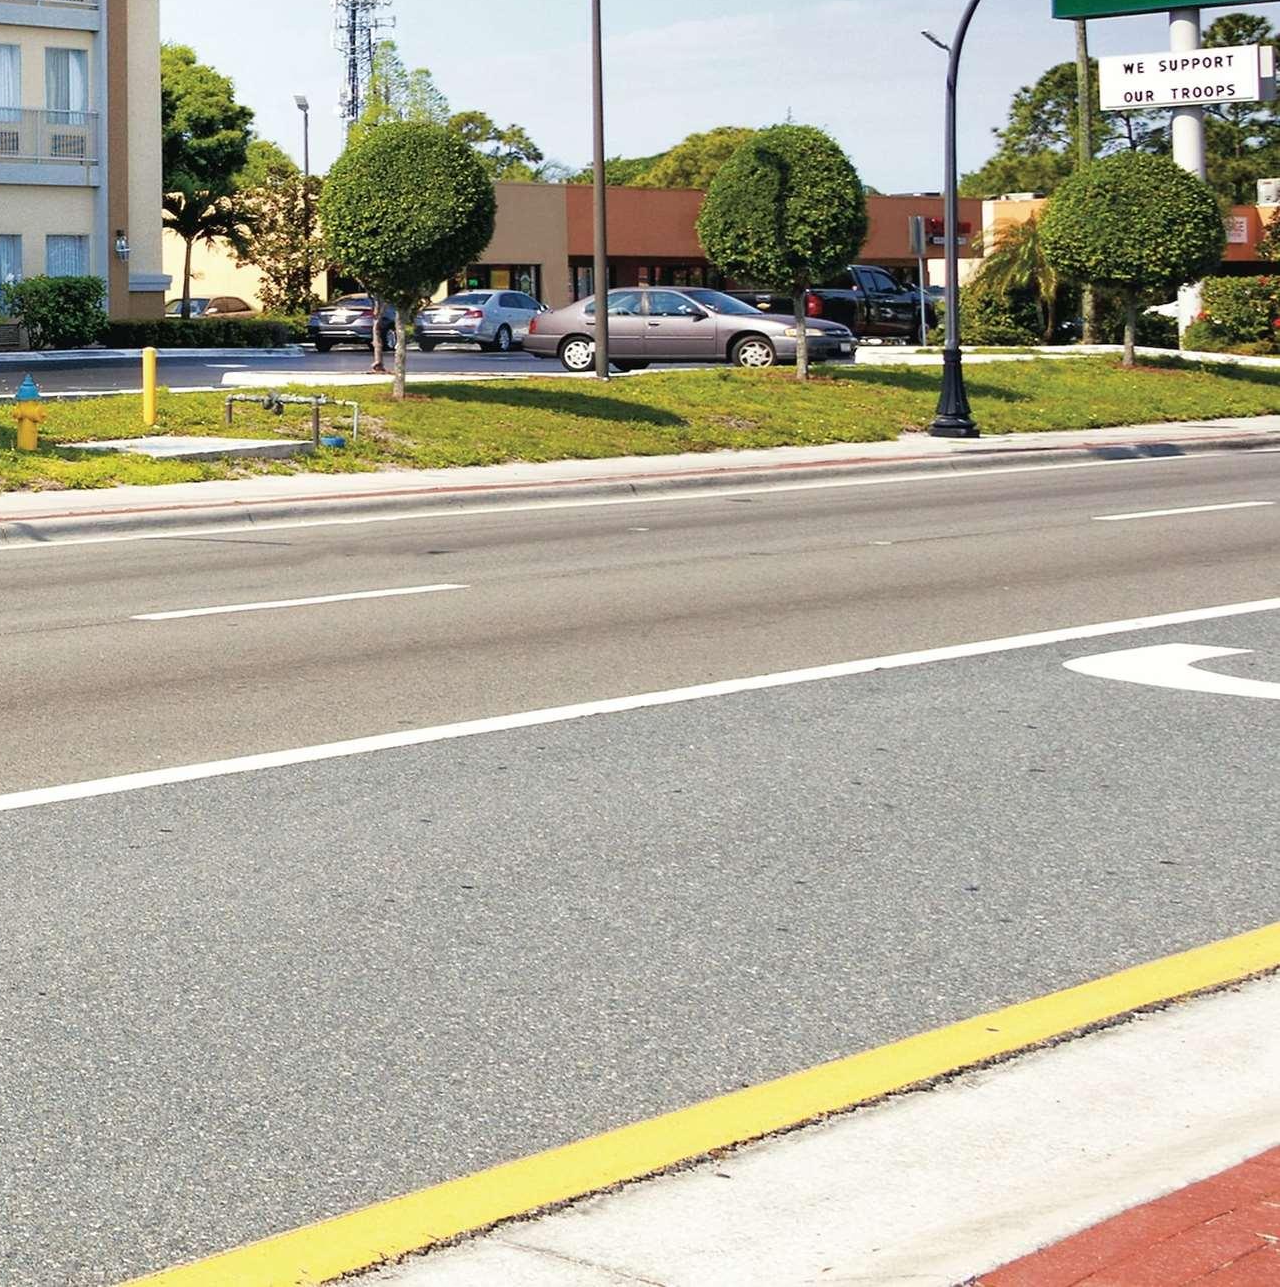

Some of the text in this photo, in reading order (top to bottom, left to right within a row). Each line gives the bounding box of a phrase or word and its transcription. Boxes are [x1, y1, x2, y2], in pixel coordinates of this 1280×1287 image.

[1124, 54, 1234, 74] WE SUPPORT
[1123, 84, 1236, 103] OUR TROOPS
